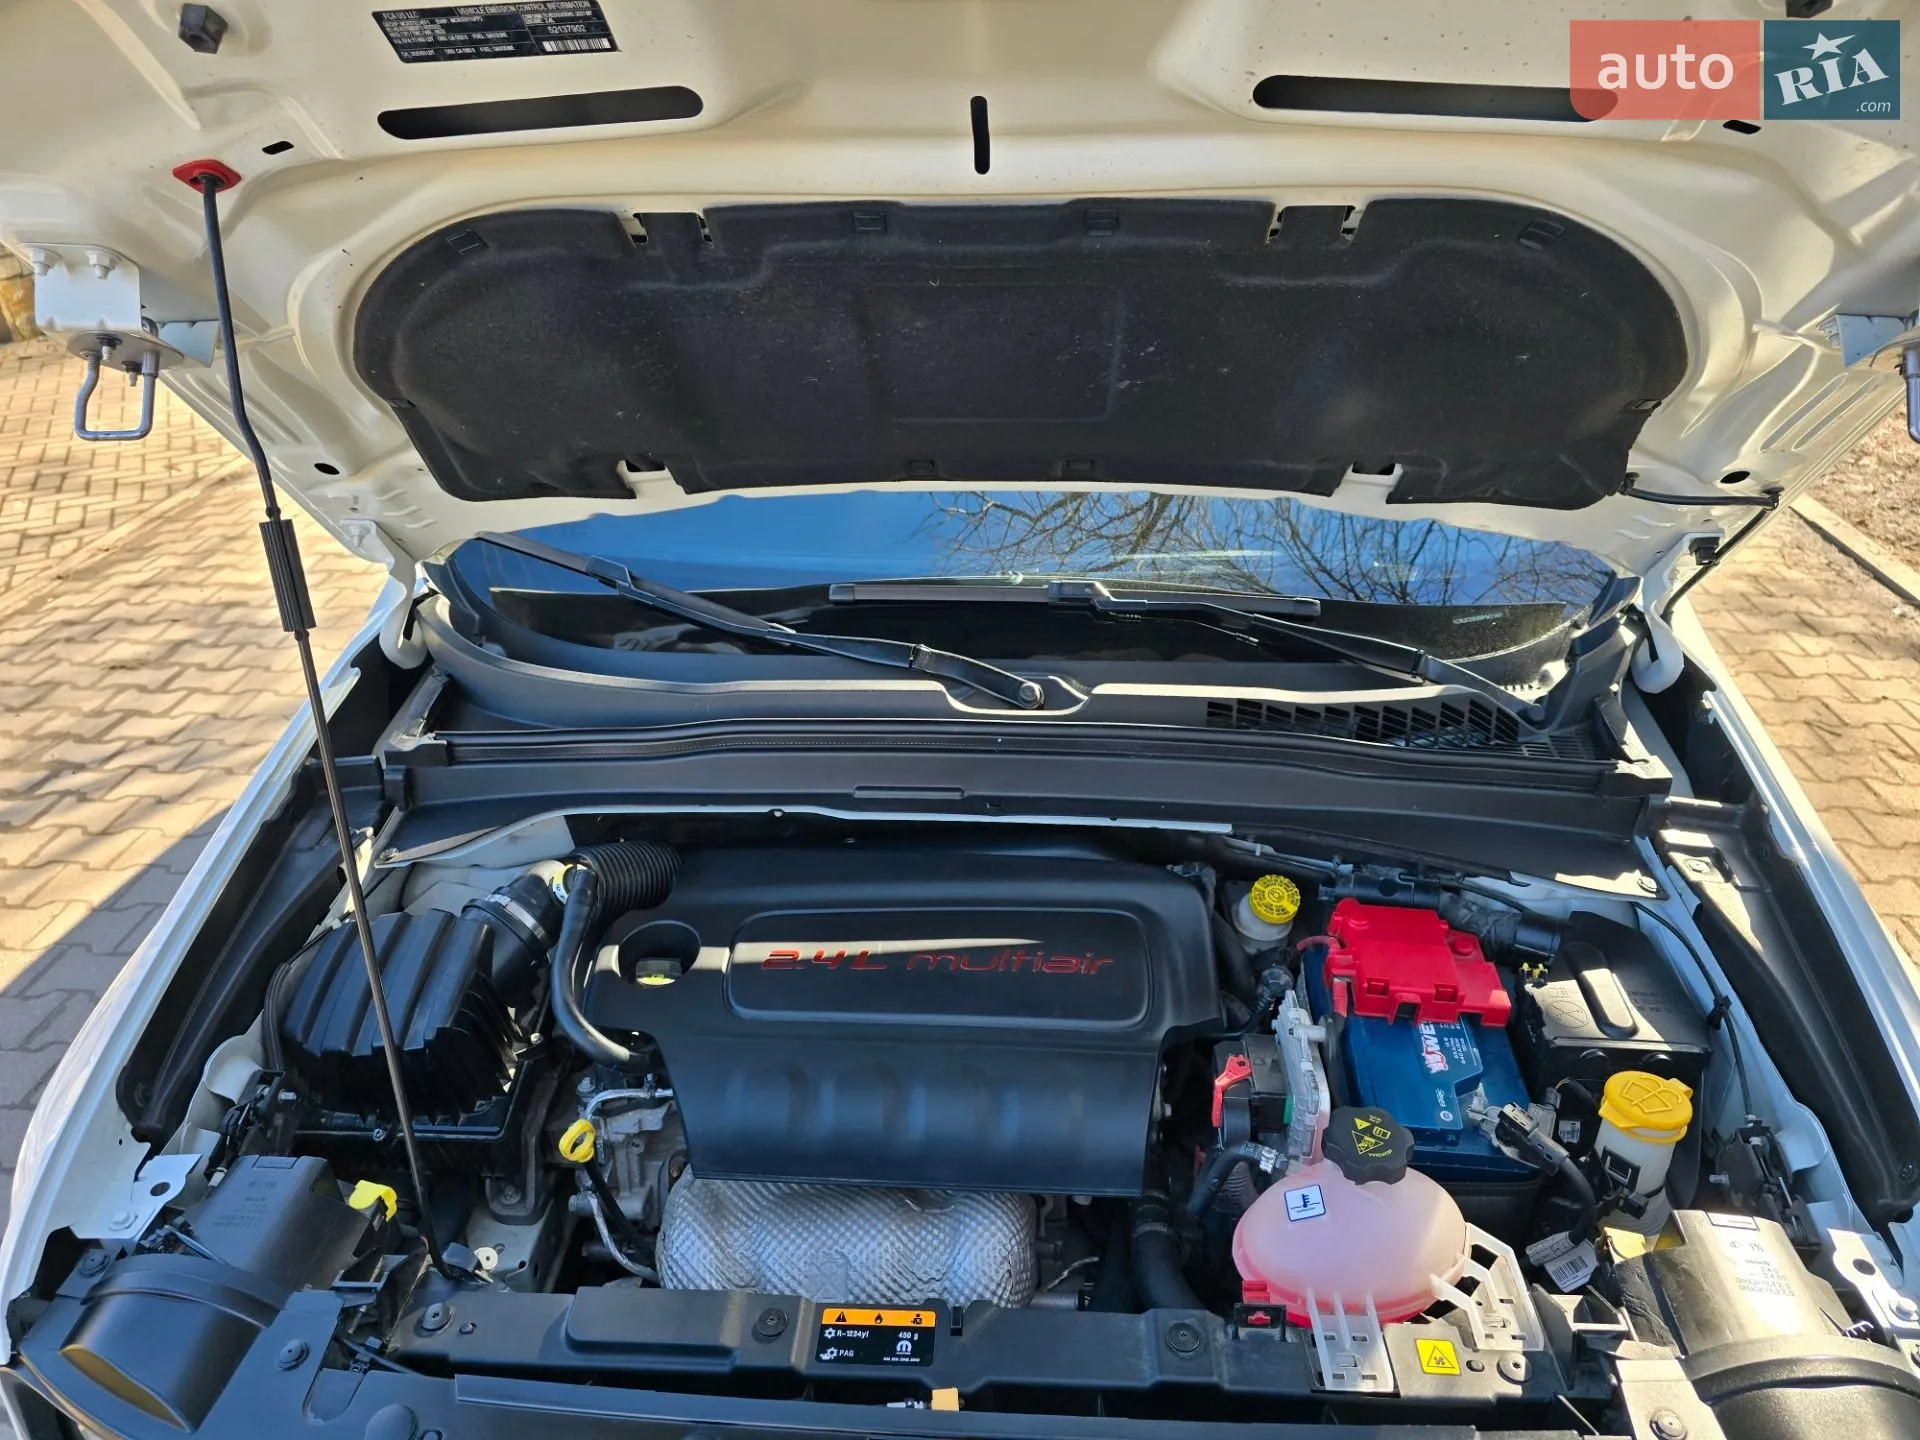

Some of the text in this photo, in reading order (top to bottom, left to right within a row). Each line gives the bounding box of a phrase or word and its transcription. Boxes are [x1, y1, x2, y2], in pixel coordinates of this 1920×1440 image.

[457, 1, 591, 15] VEHICLE EMISSION CONTROL INFORMATION
[907, 948, 1114, 974] multiair
[898, 1331, 912, 1339] 450
[839, 1349, 854, 1357] PAG
